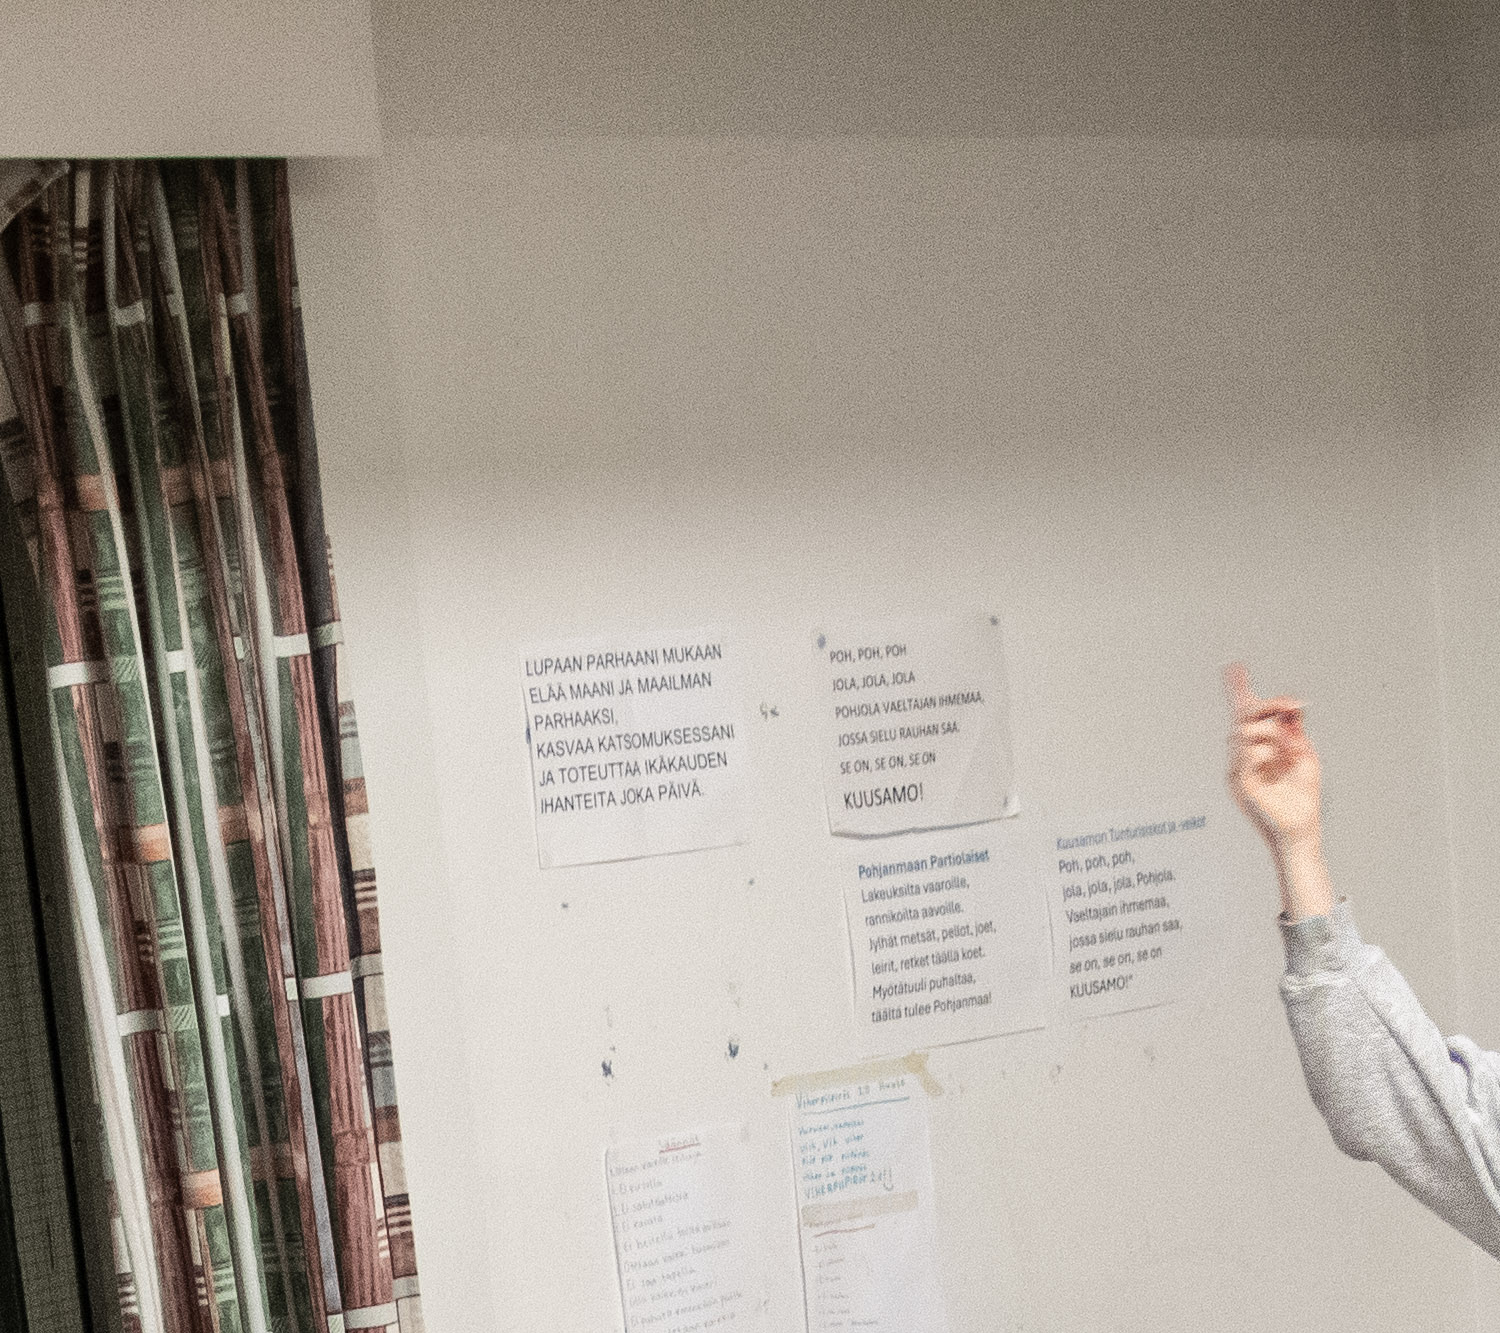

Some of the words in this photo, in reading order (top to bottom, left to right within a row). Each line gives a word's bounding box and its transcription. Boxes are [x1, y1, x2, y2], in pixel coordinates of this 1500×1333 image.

[525, 655, 583, 677] LUPAAN
[586, 649, 660, 671] PARHAANI
[662, 643, 723, 664] MUKAAN
[829, 650, 856, 664] POH,
[885, 643, 907, 659] POH
[529, 682, 567, 704] ELÄÄ
[569, 680, 615, 700] MAANI
[618, 679, 634, 696] JA
[637, 671, 713, 694] MAAILMAN
[832, 677, 860, 692] JOLA,
[891, 670, 916, 686] JOLA
[534, 707, 619, 731] PARHAAKSI,
[834, 702, 881, 720] POHJOLA
[536, 737, 595, 760] KASVAA
[598, 723, 736, 752] KATSOMUKSESSANI
[838, 730, 868, 748] JOSSA
[869, 728, 897, 745] SIELU
[899, 724, 940, 741] RAUHAN
[539, 769, 556, 787] JA
[558, 761, 642, 785] TOTEUTTAA
[645, 751, 729, 776] IKÄKAUDEN
[840, 760, 851, 775] SE
[853, 758, 873, 774] ON,
[874, 756, 885, 771] SE
[909, 752, 920, 767] SE
[921, 750, 937, 765] ON
[540, 790, 618, 815] IHANTEITA
[620, 786, 655, 806] JOKA
[658, 778, 706, 802] PÄIVÄ.
[843, 782, 924, 811] KUUSAMO!
[858, 859, 928, 881] Pohjanmaan
[930, 849, 991, 870] Partiolaiset
[861, 883, 921, 904] Lakeuksilta
[864, 908, 920, 928] rannikoilta
